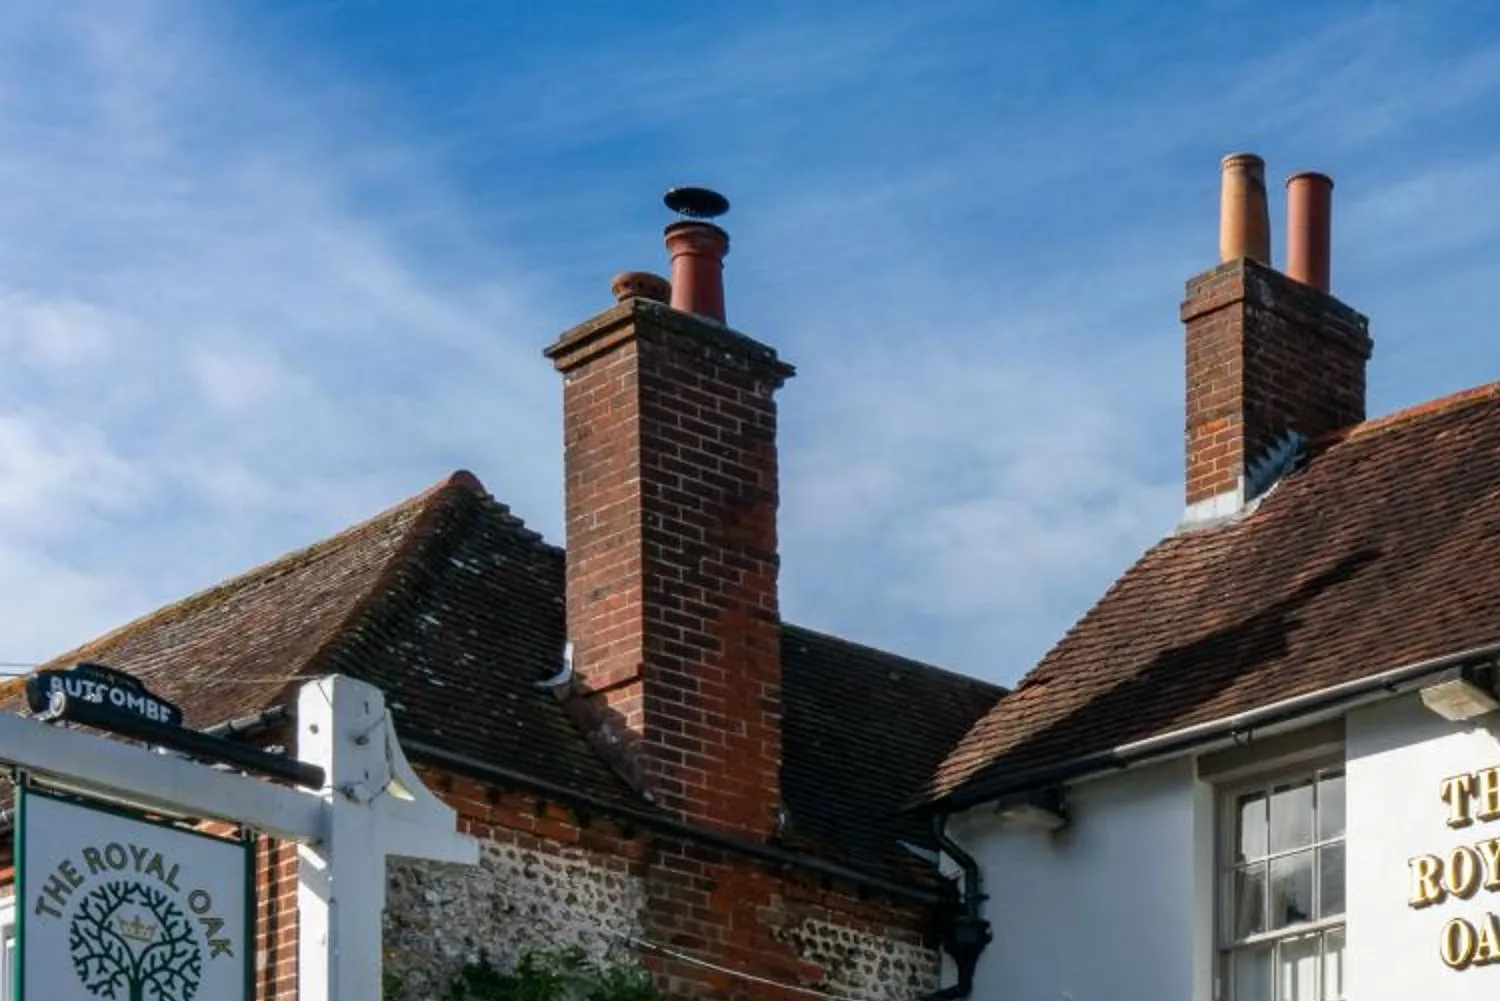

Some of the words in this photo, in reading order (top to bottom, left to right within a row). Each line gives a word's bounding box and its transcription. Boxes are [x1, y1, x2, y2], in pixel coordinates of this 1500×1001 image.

[48, 676, 172, 723] BUTCOMBE
[34, 859, 85, 920] THE
[83, 841, 181, 893] ROYAL
[187, 889, 235, 960] OAK
